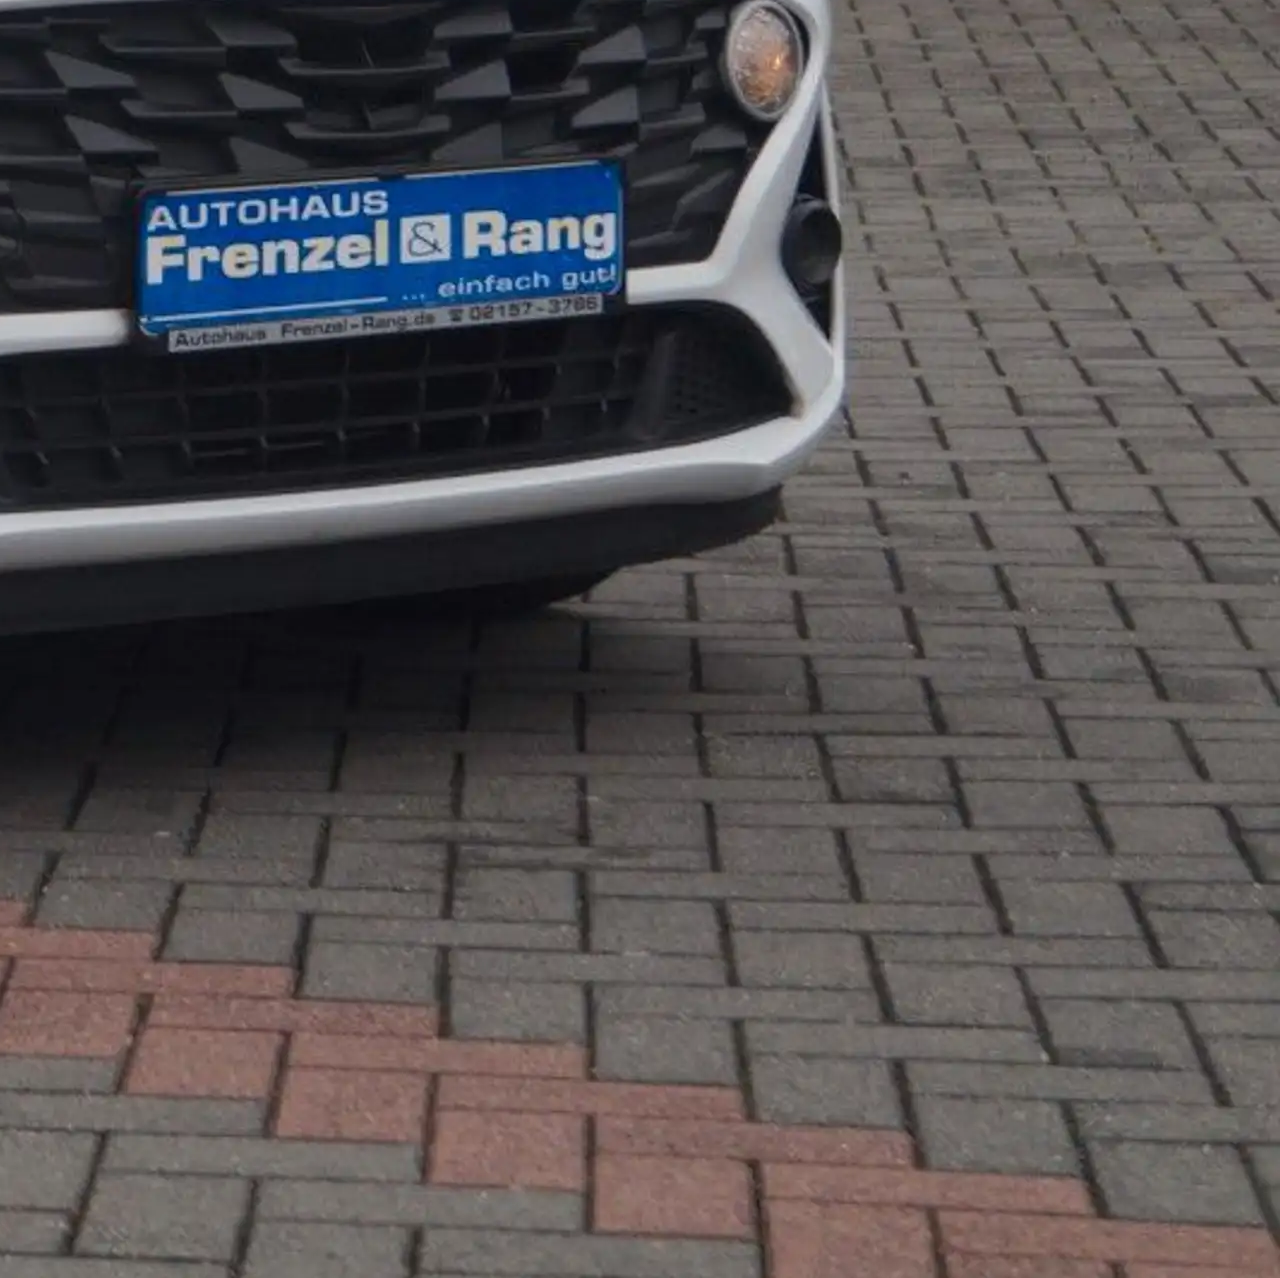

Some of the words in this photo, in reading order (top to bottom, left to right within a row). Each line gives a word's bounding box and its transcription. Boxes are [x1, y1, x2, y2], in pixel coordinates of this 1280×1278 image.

[146, 190, 389, 232] AUTOHAUS
[146, 219, 389, 286] Frenzel
[404, 217, 447, 260] &
[462, 209, 617, 262] Rang
[438, 270, 551, 298] einfach
[561, 263, 617, 291] gut!
[174, 326, 267, 348] Autohaus
